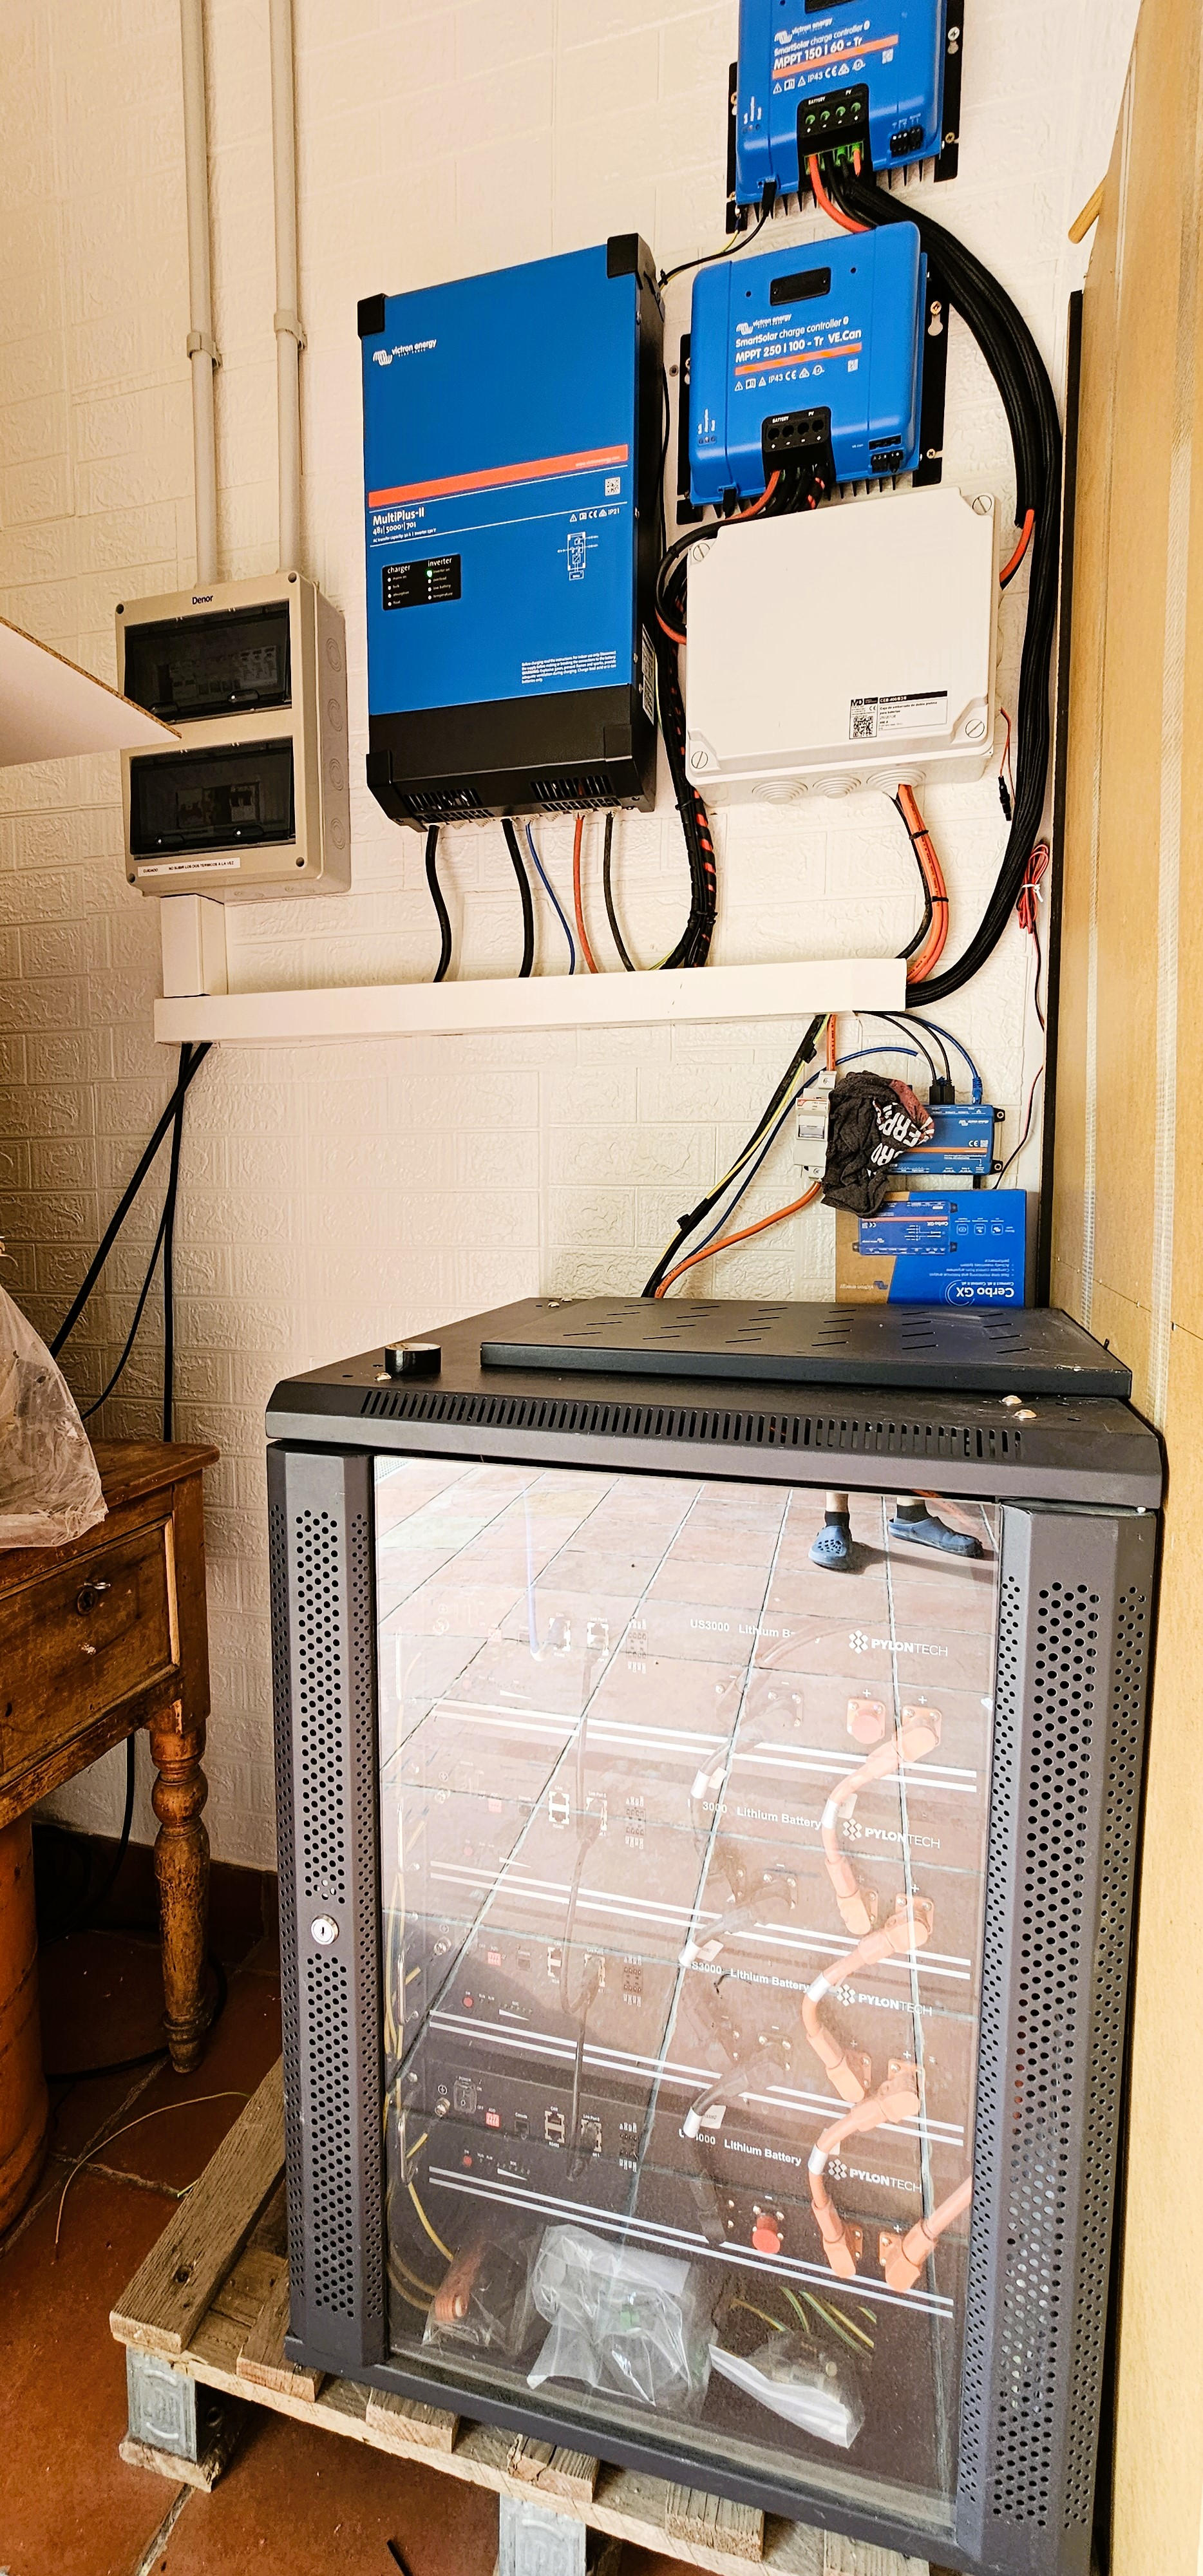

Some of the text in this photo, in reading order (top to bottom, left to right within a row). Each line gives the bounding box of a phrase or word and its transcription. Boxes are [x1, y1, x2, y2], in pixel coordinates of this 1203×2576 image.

[775, 24, 863, 57] SmartSolar charge controller
[773, 52, 802, 70] MPPT
[805, 46, 822, 61] 150
[830, 39, 844, 53] 60
[853, 36, 862, 48] Tr
[808, 71, 823, 82] IP43
[808, 96, 826, 105] BATTERY
[735, 318, 842, 348] SmartSolar charge controller
[392, 345, 413, 355] victron
[414, 339, 437, 349] energy
[735, 347, 761, 363] MPPT
[763, 343, 781, 357] 250
[789, 339, 805, 352] 100
[813, 336, 824, 346] Tr
[828, 329, 862, 344] VE.Can
[768, 373, 783, 384] IP43
[373, 507, 424, 526] MultiPlus-II
[388, 565, 411, 574] charger
[428, 558, 452, 567] inverter
[193, 595, 213, 605] Denor
[956, 1287, 1014, 1298] Cerbo GX
[690, 1618, 730, 1632] US3000
[739, 1624, 779, 1638] Lithium
[871, 1638, 948, 1657] PYLONTECH
[737, 1807, 778, 1823] Lithium
[781, 1814, 822, 1831] Battery
[865, 1828, 940, 1849] PYLONTECH
[690, 1960, 810, 1994] S3000 Lithium Battery
[858, 1993, 933, 2016] PYLONTECH
[724, 2139, 762, 2156] Lithium
[764, 2148, 801, 2166] Battery
[849, 2167, 922, 2193] PYLONTECH
